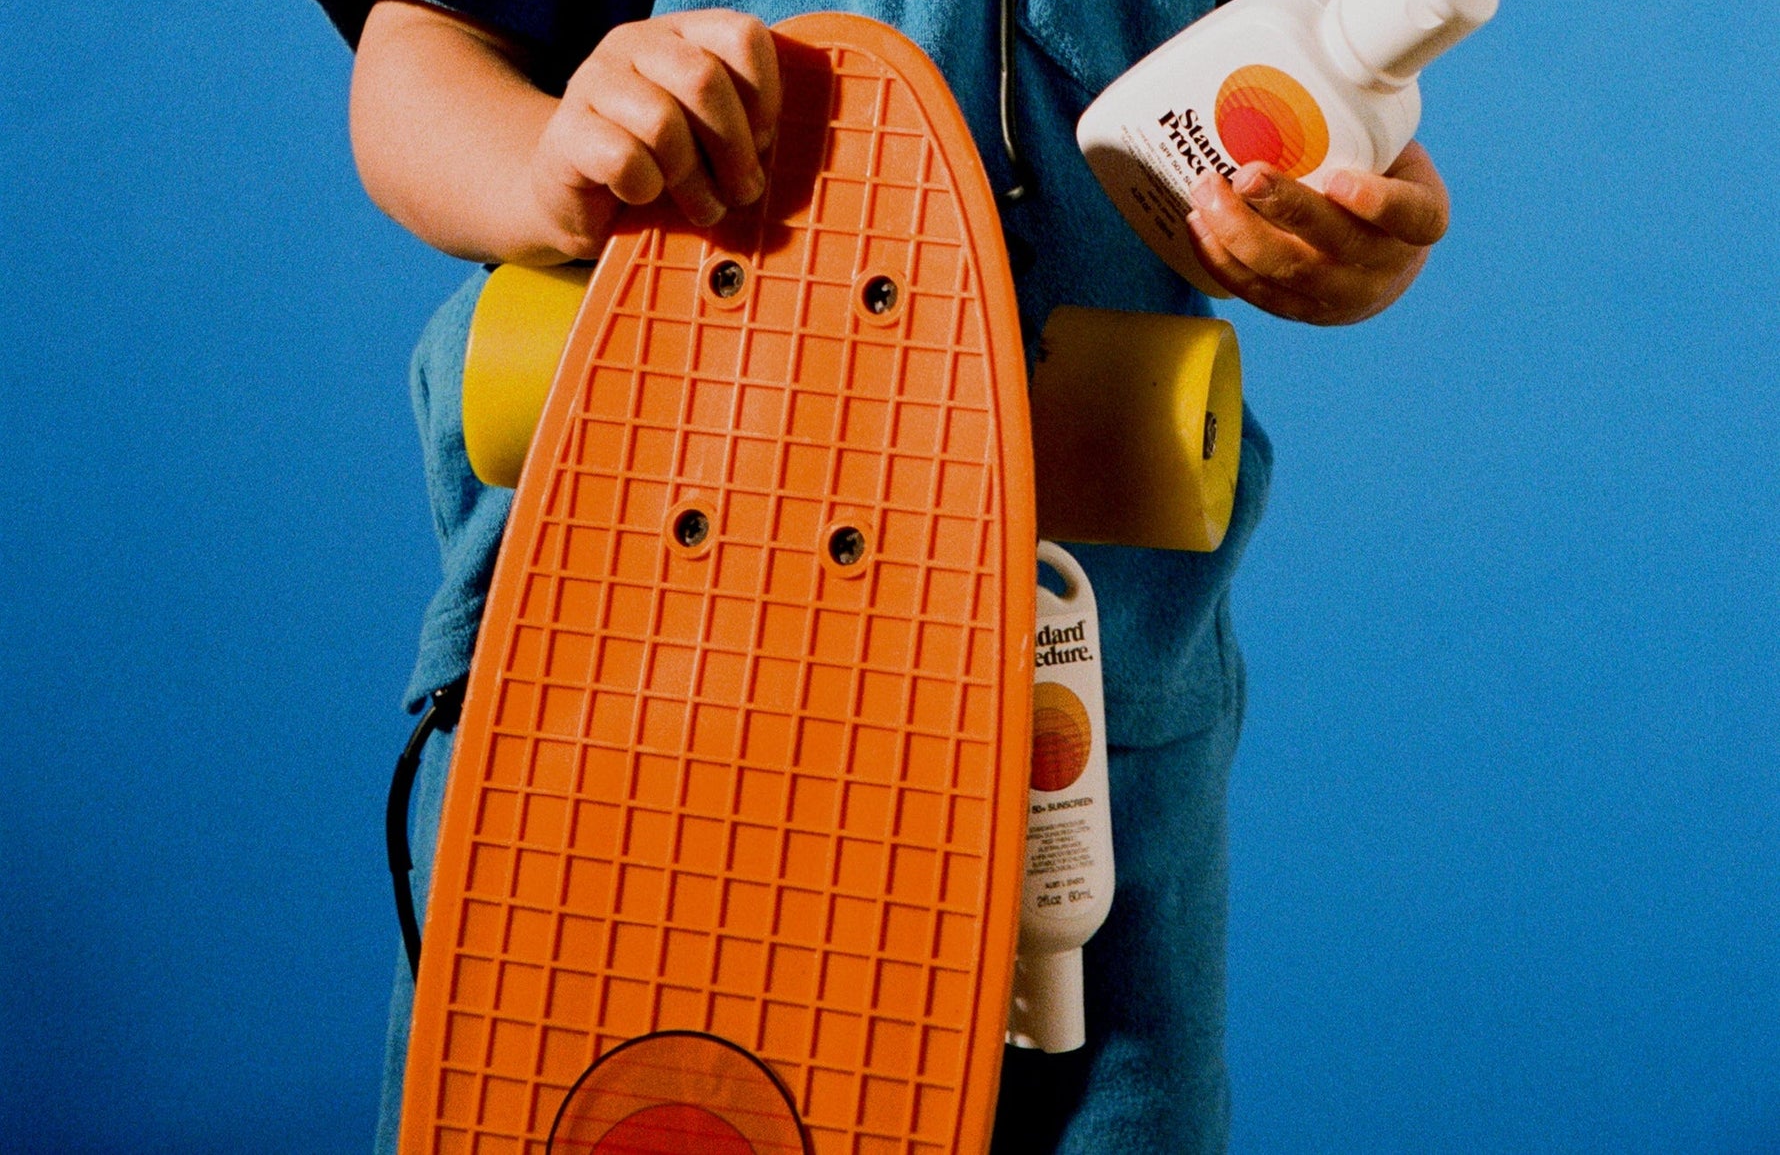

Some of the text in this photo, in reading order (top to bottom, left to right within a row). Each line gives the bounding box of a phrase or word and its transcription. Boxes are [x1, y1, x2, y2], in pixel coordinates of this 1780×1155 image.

[1159, 141, 1173, 158] SPF
[1178, 108, 1238, 185] Stand
[1035, 618, 1086, 647] dard
[1047, 797, 1094, 812] SUNSCREEN
